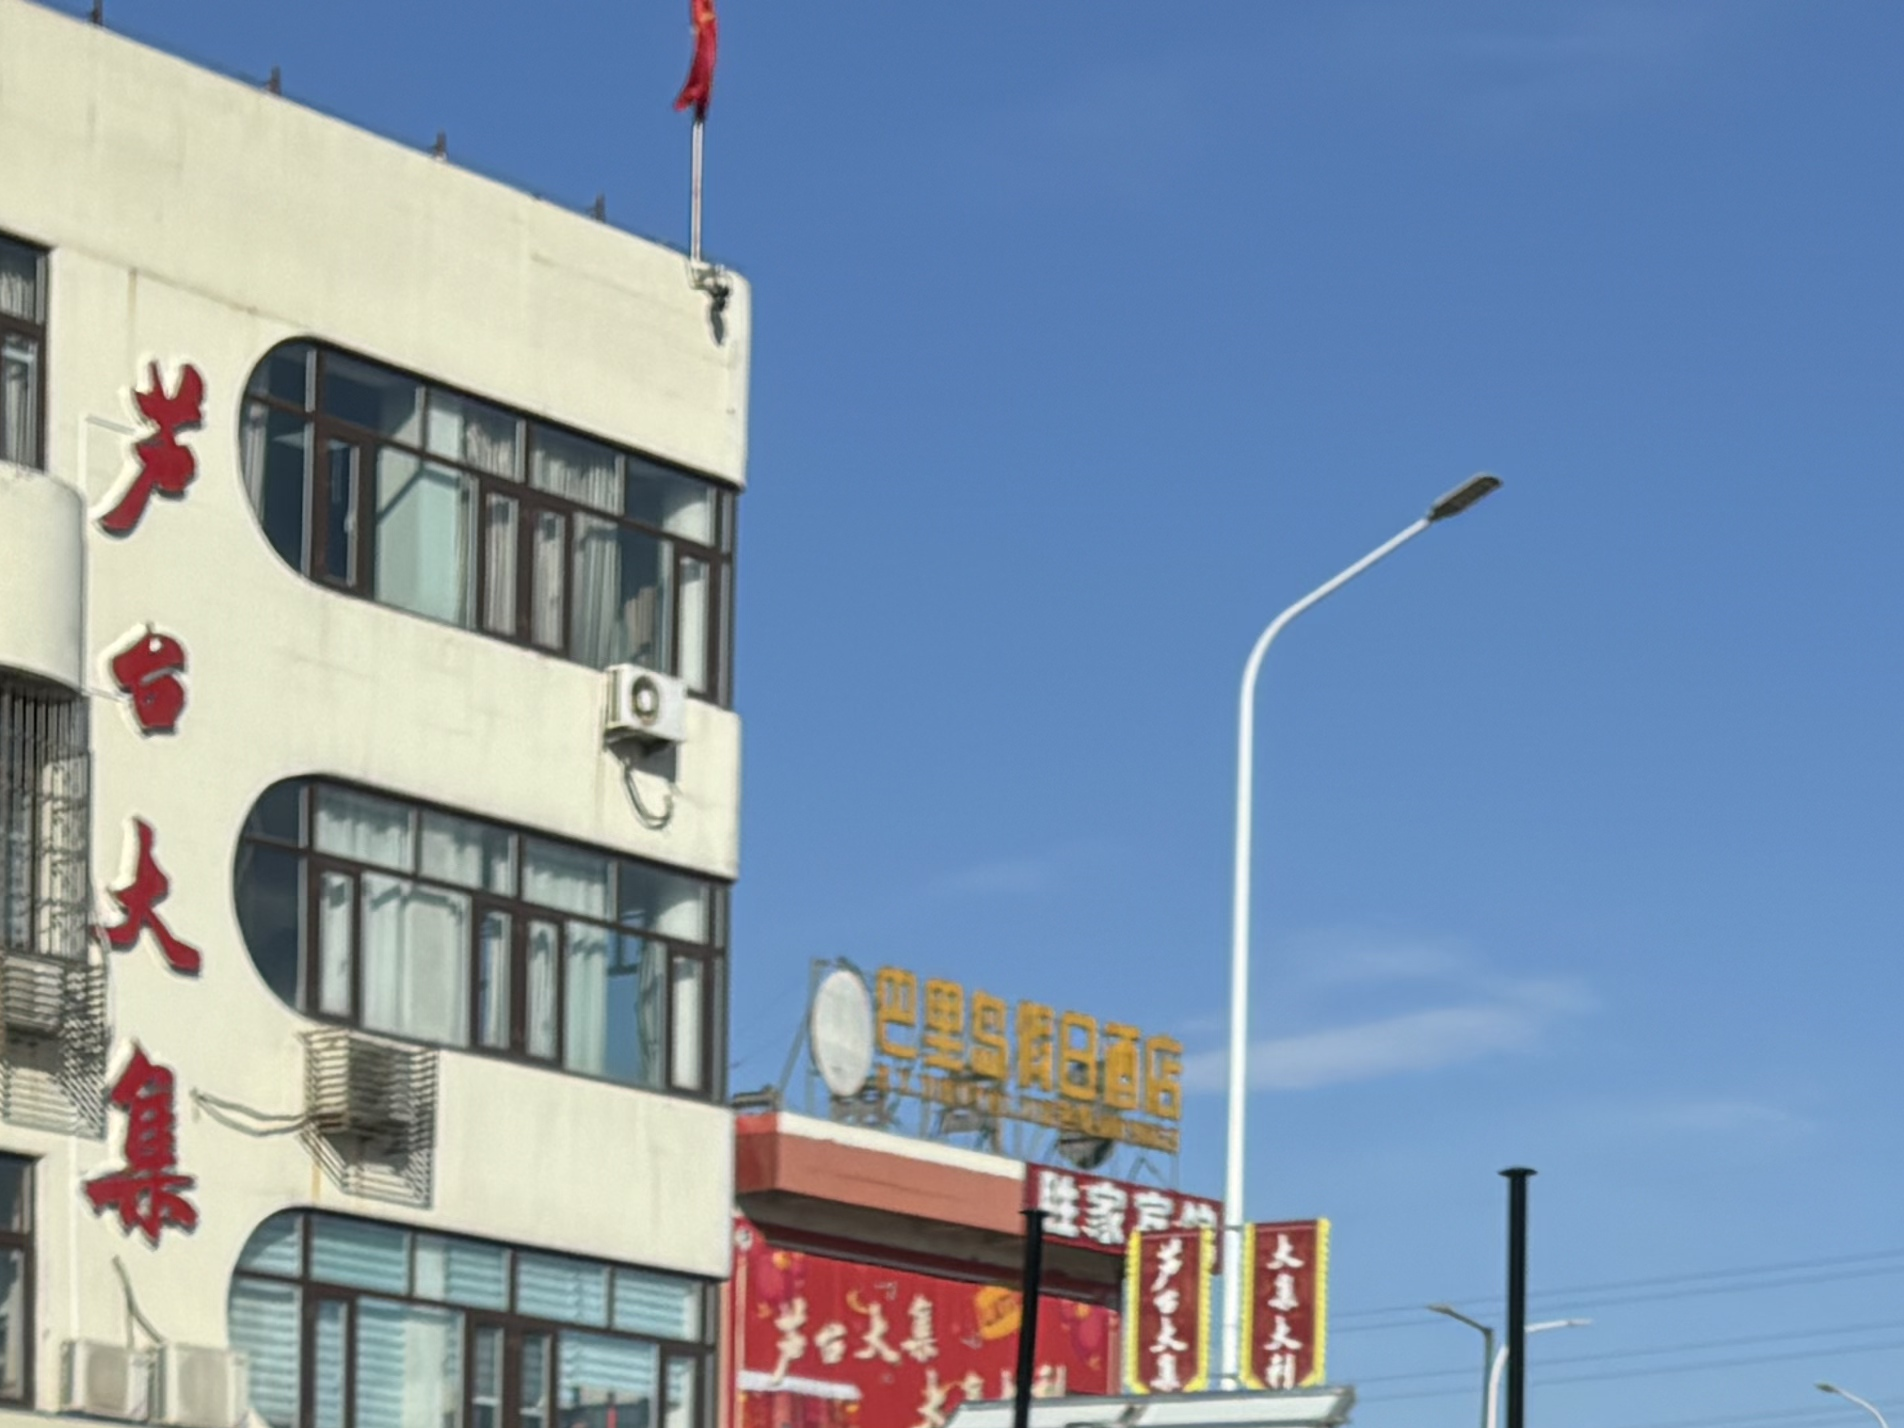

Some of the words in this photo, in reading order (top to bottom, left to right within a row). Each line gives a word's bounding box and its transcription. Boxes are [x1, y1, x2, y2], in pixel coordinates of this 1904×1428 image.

[82, 360, 208, 1243] 芦台大集
[876, 966, 1183, 1121] 巴里岛假日酒店
[773, 1294, 939, 1385] 芦台大集
[1150, 1237, 1188, 1391] 芦台大集
[1264, 1233, 1305, 1390] 大集大利
